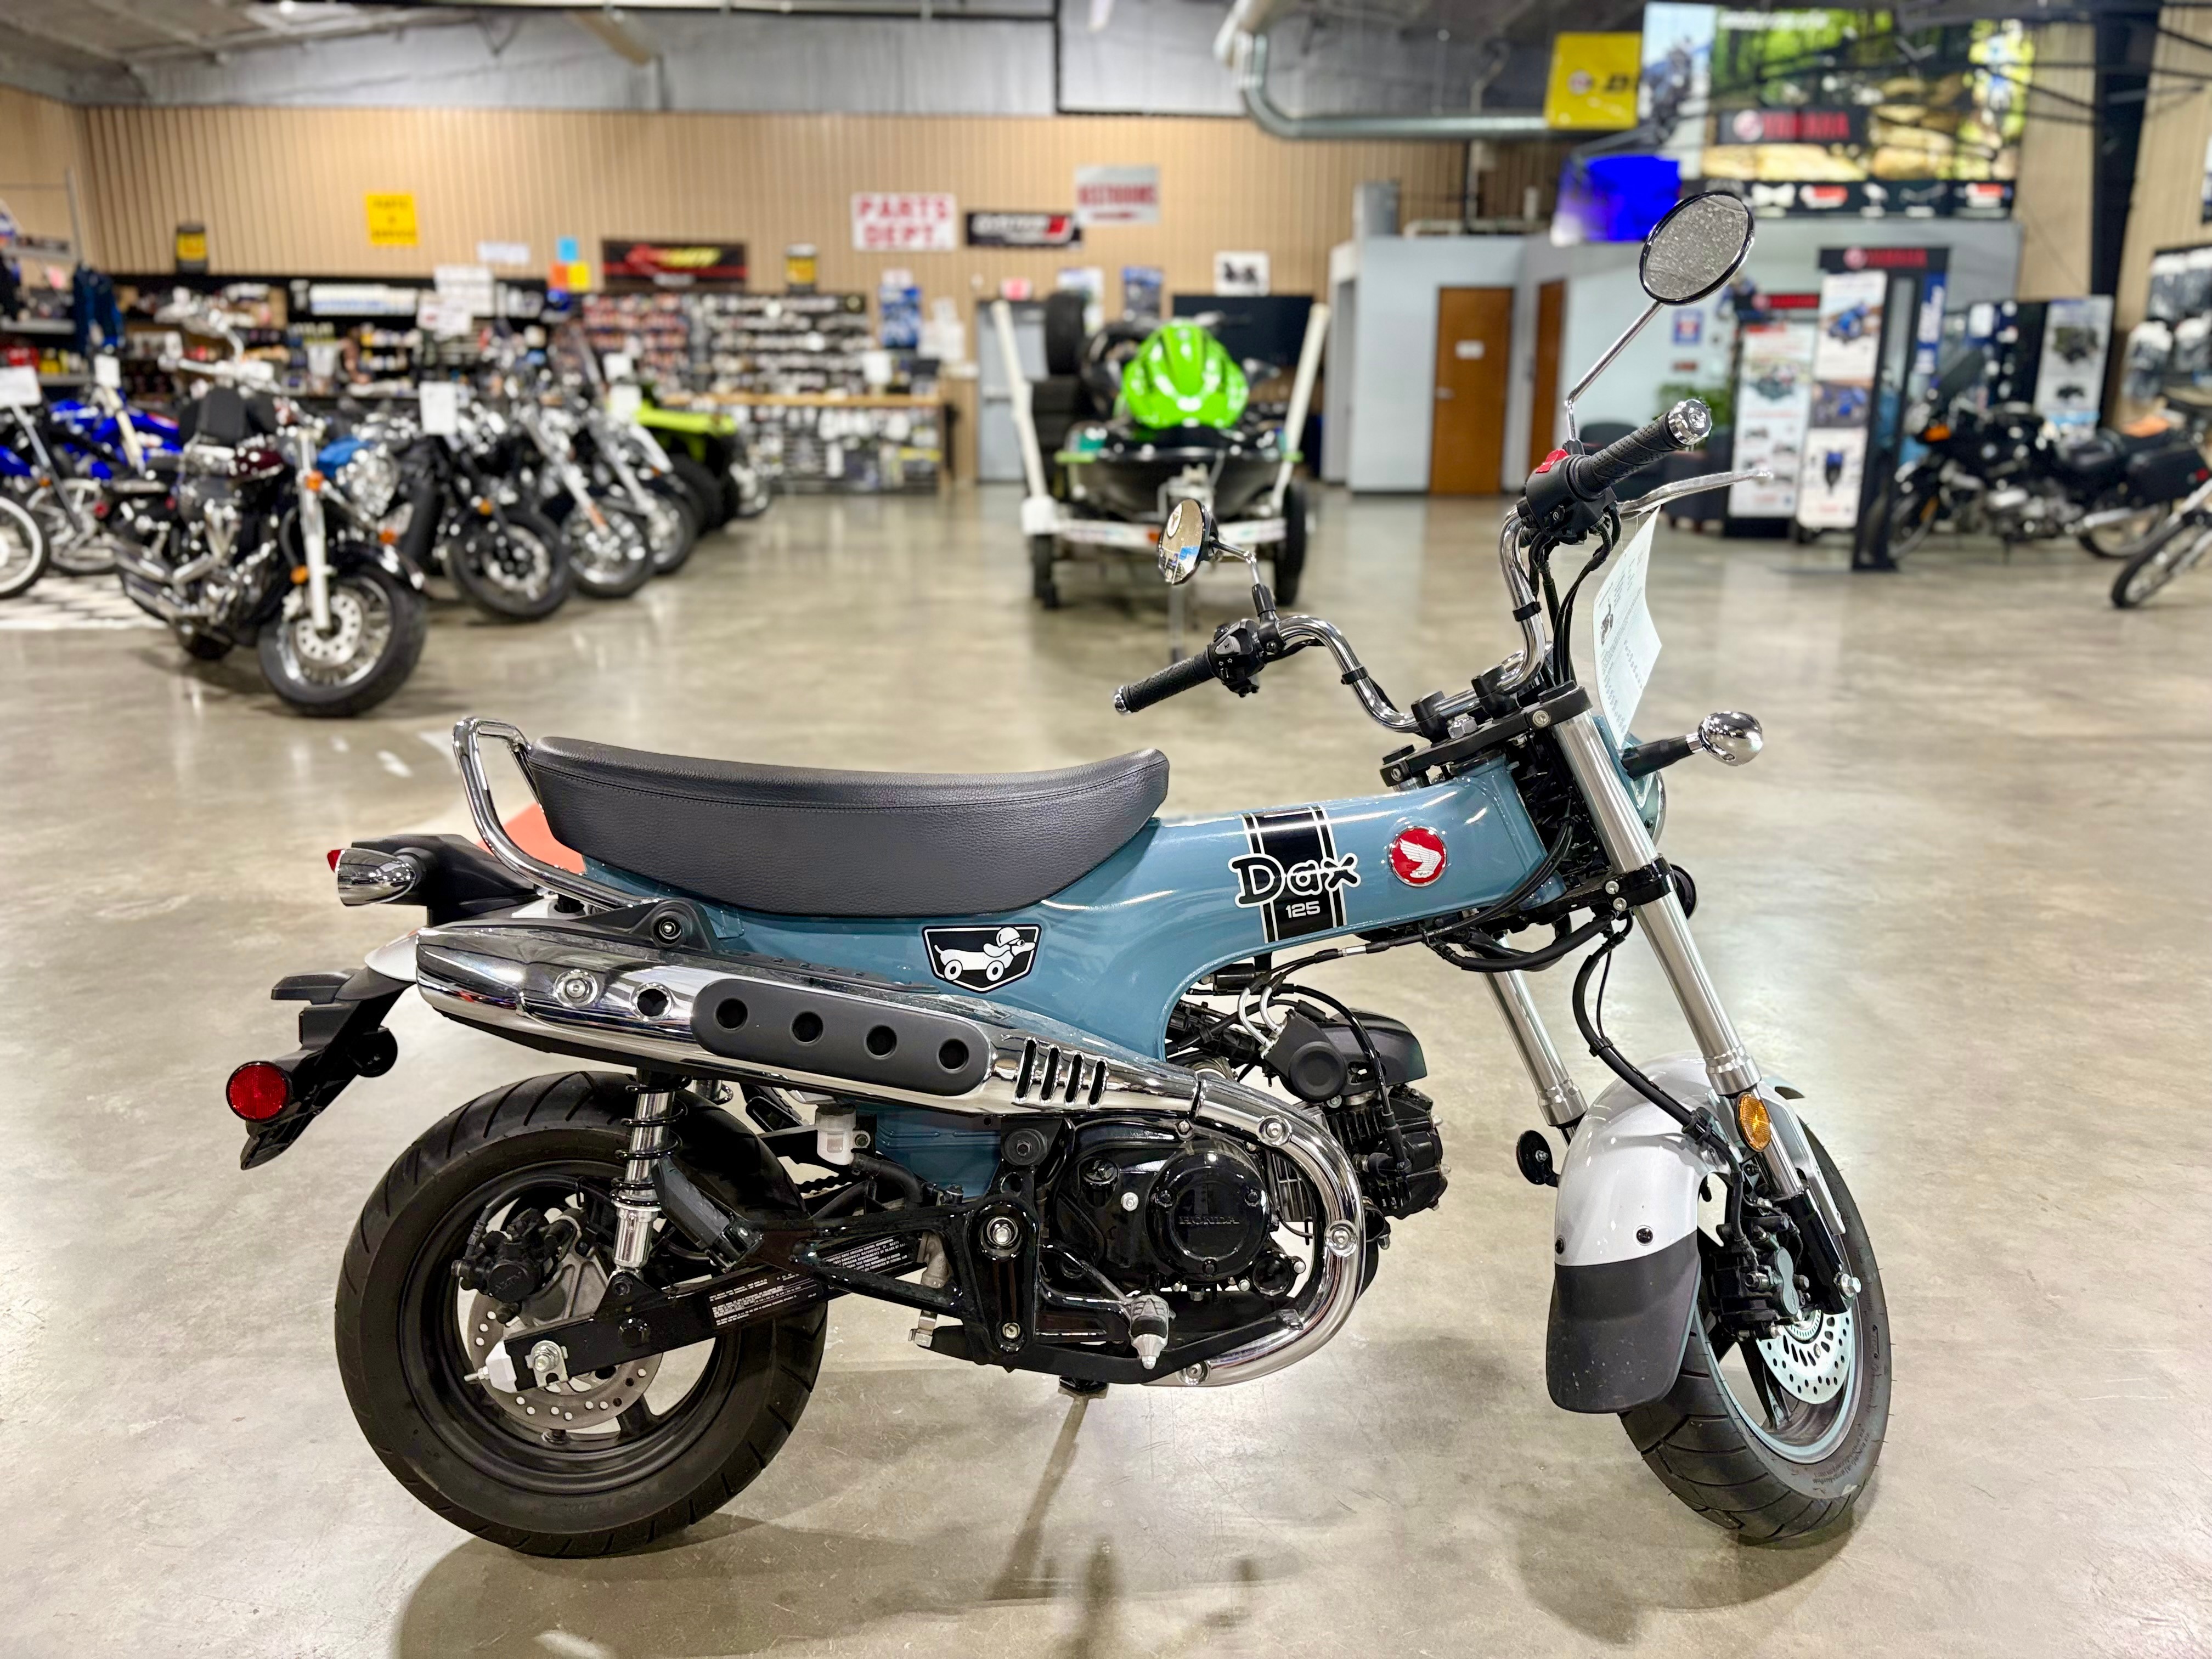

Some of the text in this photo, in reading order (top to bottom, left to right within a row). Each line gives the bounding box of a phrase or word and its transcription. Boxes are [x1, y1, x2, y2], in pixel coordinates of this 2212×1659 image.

[856, 196, 949, 220] PARTS
[1228, 853, 1361, 908] Dax
[1285, 900, 1321, 918] 125
